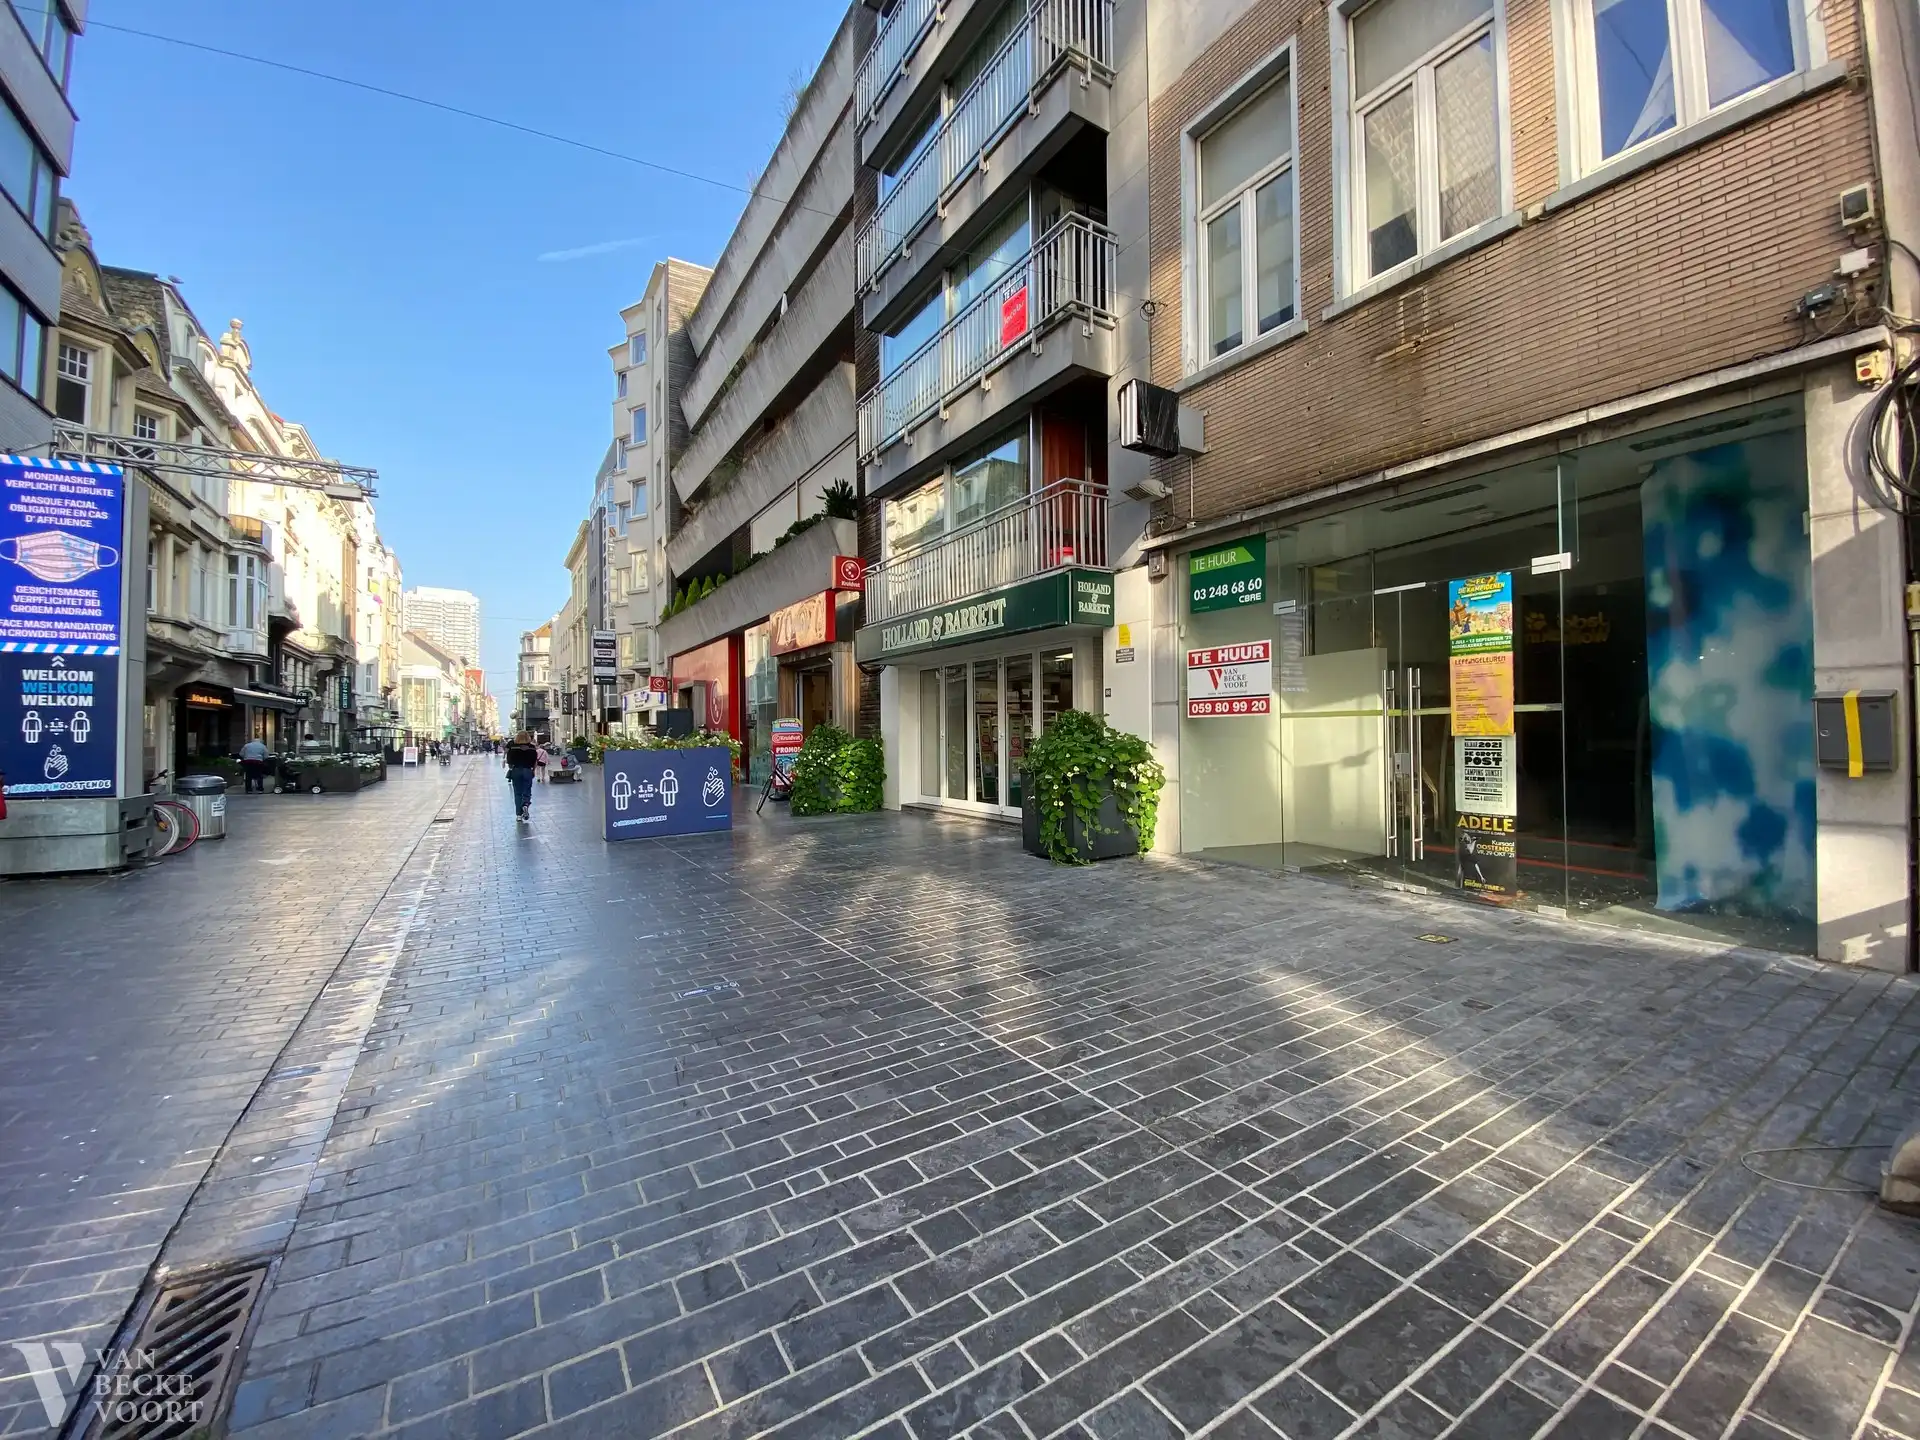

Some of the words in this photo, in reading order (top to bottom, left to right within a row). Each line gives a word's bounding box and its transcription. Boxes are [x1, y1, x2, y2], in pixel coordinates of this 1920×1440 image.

[24, 471, 97, 485] MONDMASKER
[5, 479, 58, 491] VERPLICHT
[60, 485, 75, 493] BIJ
[76, 486, 115, 497] DRUKTE
[21, 495, 63, 506] MASQUE
[65, 499, 98, 509] FACIAL
[10, 503, 72, 517] OBLIGATOIRE
[73, 509, 87, 517] EN
[88, 511, 108, 520] CAS
[37, 516, 92, 528] AFFLUENCE
[1195, 559, 1205, 571] TE
[1207, 551, 1237, 568] HUUR
[16, 585, 98, 598] GESICHTSMASKE
[1077, 581, 1111, 595] HOLLAND
[1193, 588, 1207, 601] 03
[1208, 584, 1229, 599] 248
[1231, 580, 1245, 594] 68
[1247, 577, 1262, 591] 60
[13, 594, 83, 606] VERPFLICHTET
[85, 598, 100, 607] BEI
[1091, 592, 1099, 603] &
[1238, 592, 1262, 603] CBRE
[54, 606, 102, 617] ANDRANG
[1078, 601, 1111, 615] BARRETT
[24, 620, 53, 629] MASK
[54, 621, 114, 632] MANDATORY
[882, 619, 932, 651] HOLLAND
[931, 615, 943, 642] &
[942, 598, 1006, 638] BARRETT
[8, 628, 57, 639] CROWDED
[59, 631, 116, 641] SITUATIONS
[1191, 652, 1212, 665] TE
[1217, 645, 1265, 662] HUUR
[22, 669, 94, 682] WELKOM
[1223, 674, 1247, 682] BECKE
[22, 682, 93, 694] WELKOM
[1223, 681, 1248, 689] VOORT
[22, 694, 93, 707] WELKOM
[1191, 703, 1212, 714] 059
[1214, 702, 1229, 713] 80
[1232, 701, 1248, 712] 99
[1251, 700, 1267, 712] 20
[1465, 757, 1502, 765] POST
[638, 784, 654, 794] 1,5
[1457, 814, 1515, 832] ADELE
[1476, 844, 1515, 852] OOSTENDE
